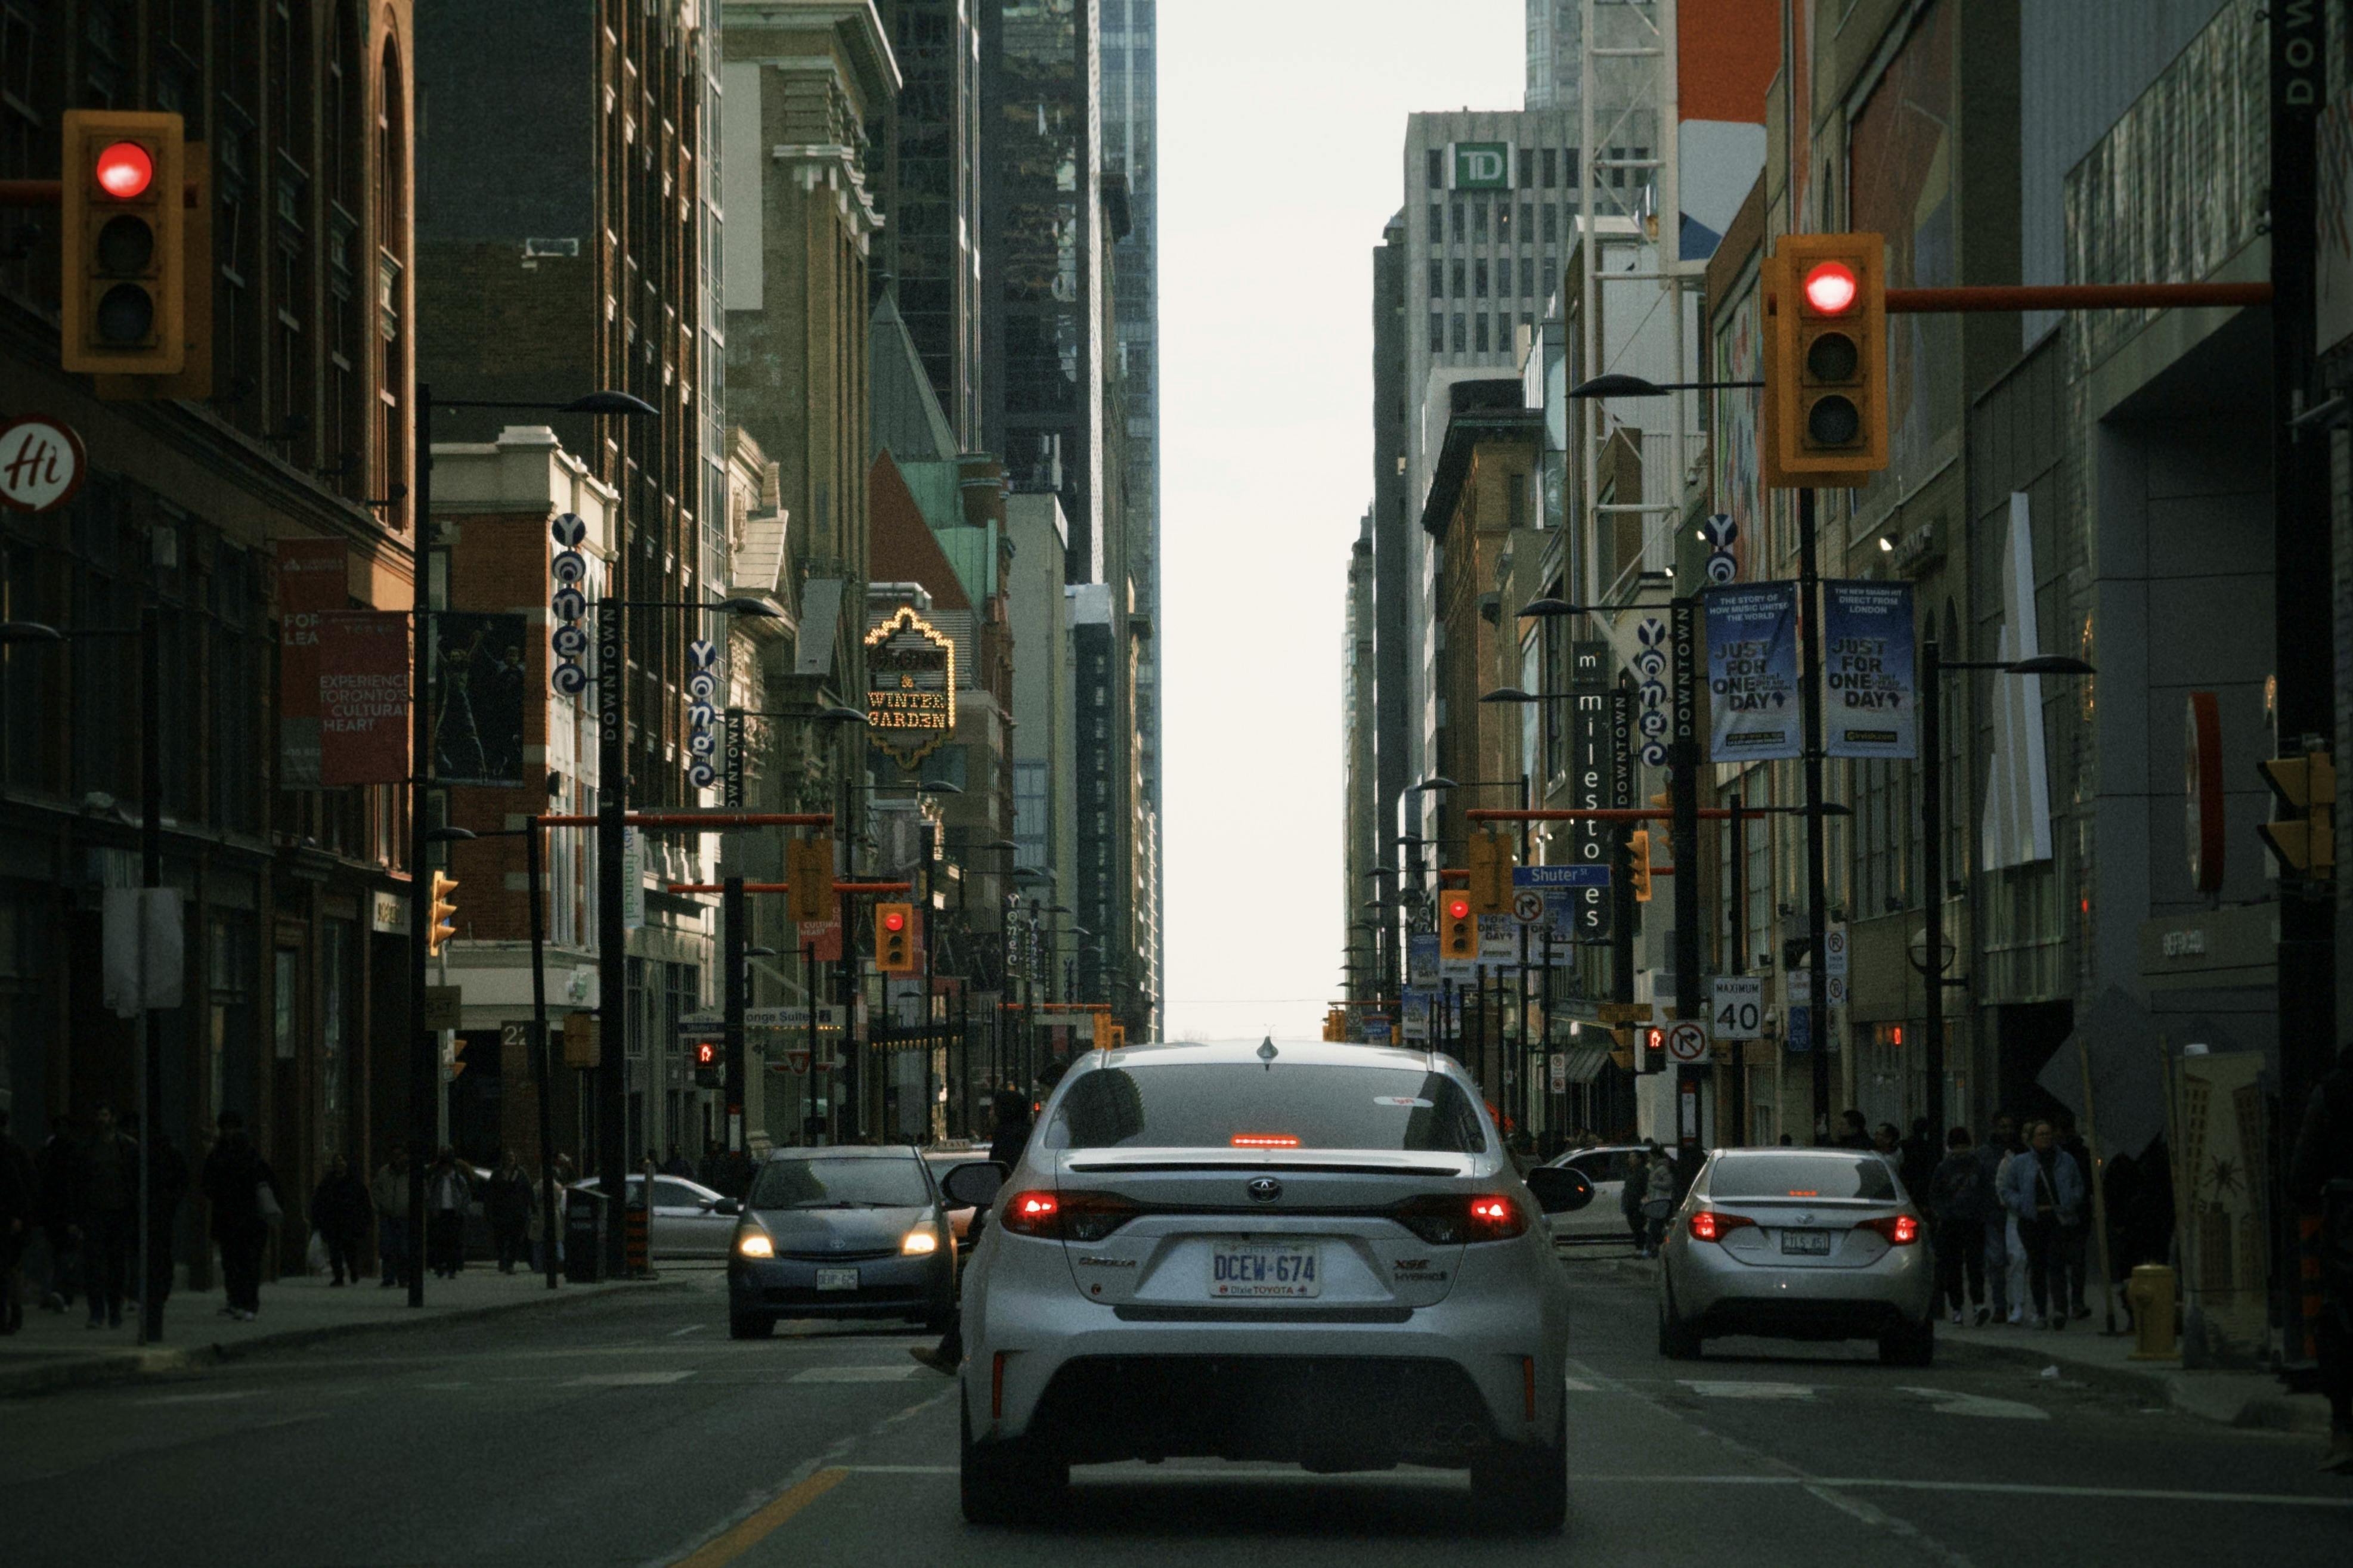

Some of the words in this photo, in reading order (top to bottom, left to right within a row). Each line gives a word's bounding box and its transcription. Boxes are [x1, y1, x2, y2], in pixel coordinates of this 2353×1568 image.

[1460, 151, 1503, 181] TD
[4, 433, 61, 490] Hi
[1720, 597, 1736, 605] THE
[1738, 595, 1765, 604] STORY
[1839, 596, 1871, 605] DIRECT
[1873, 597, 1898, 605] FROM
[1710, 606, 1730, 615] HOW
[1731, 604, 1758, 613] MUSIC
[1744, 612, 1774, 621] WORLD
[1850, 605, 1887, 614] LONDON
[1714, 638, 1770, 660] JUST
[1831, 637, 1887, 655] JUST
[1678, 606, 1691, 737] DOWNTOWN
[1726, 658, 1766, 676] FOR
[1842, 655, 1882, 673] FOR
[603, 608, 616, 740] DOWNTOWN
[1828, 673, 1872, 690] ONE
[1712, 676, 1756, 695] ONE
[868, 692, 945, 709] WINTER
[1729, 692, 1770, 711] DAY
[1845, 690, 1885, 708] DAY
[323, 718, 374, 733] HEART
[868, 711, 945, 728] GARDEN
[1615, 696, 1627, 805] DOWNTOWN
[728, 717, 739, 808] OWNTOWN
[1580, 696, 1602, 926] milestoes
[623, 826, 640, 919] asyfinancial
[1531, 868, 1577, 882] Shuter
[1716, 984, 1758, 993] MAXIMUM
[746, 1014, 775, 1024] onge
[779, 1011, 810, 1022] Suite
[1717, 1003, 1758, 1031] 40
[1215, 1255, 1265, 1281] DCEW
[1277, 1256, 1315, 1282] 674
